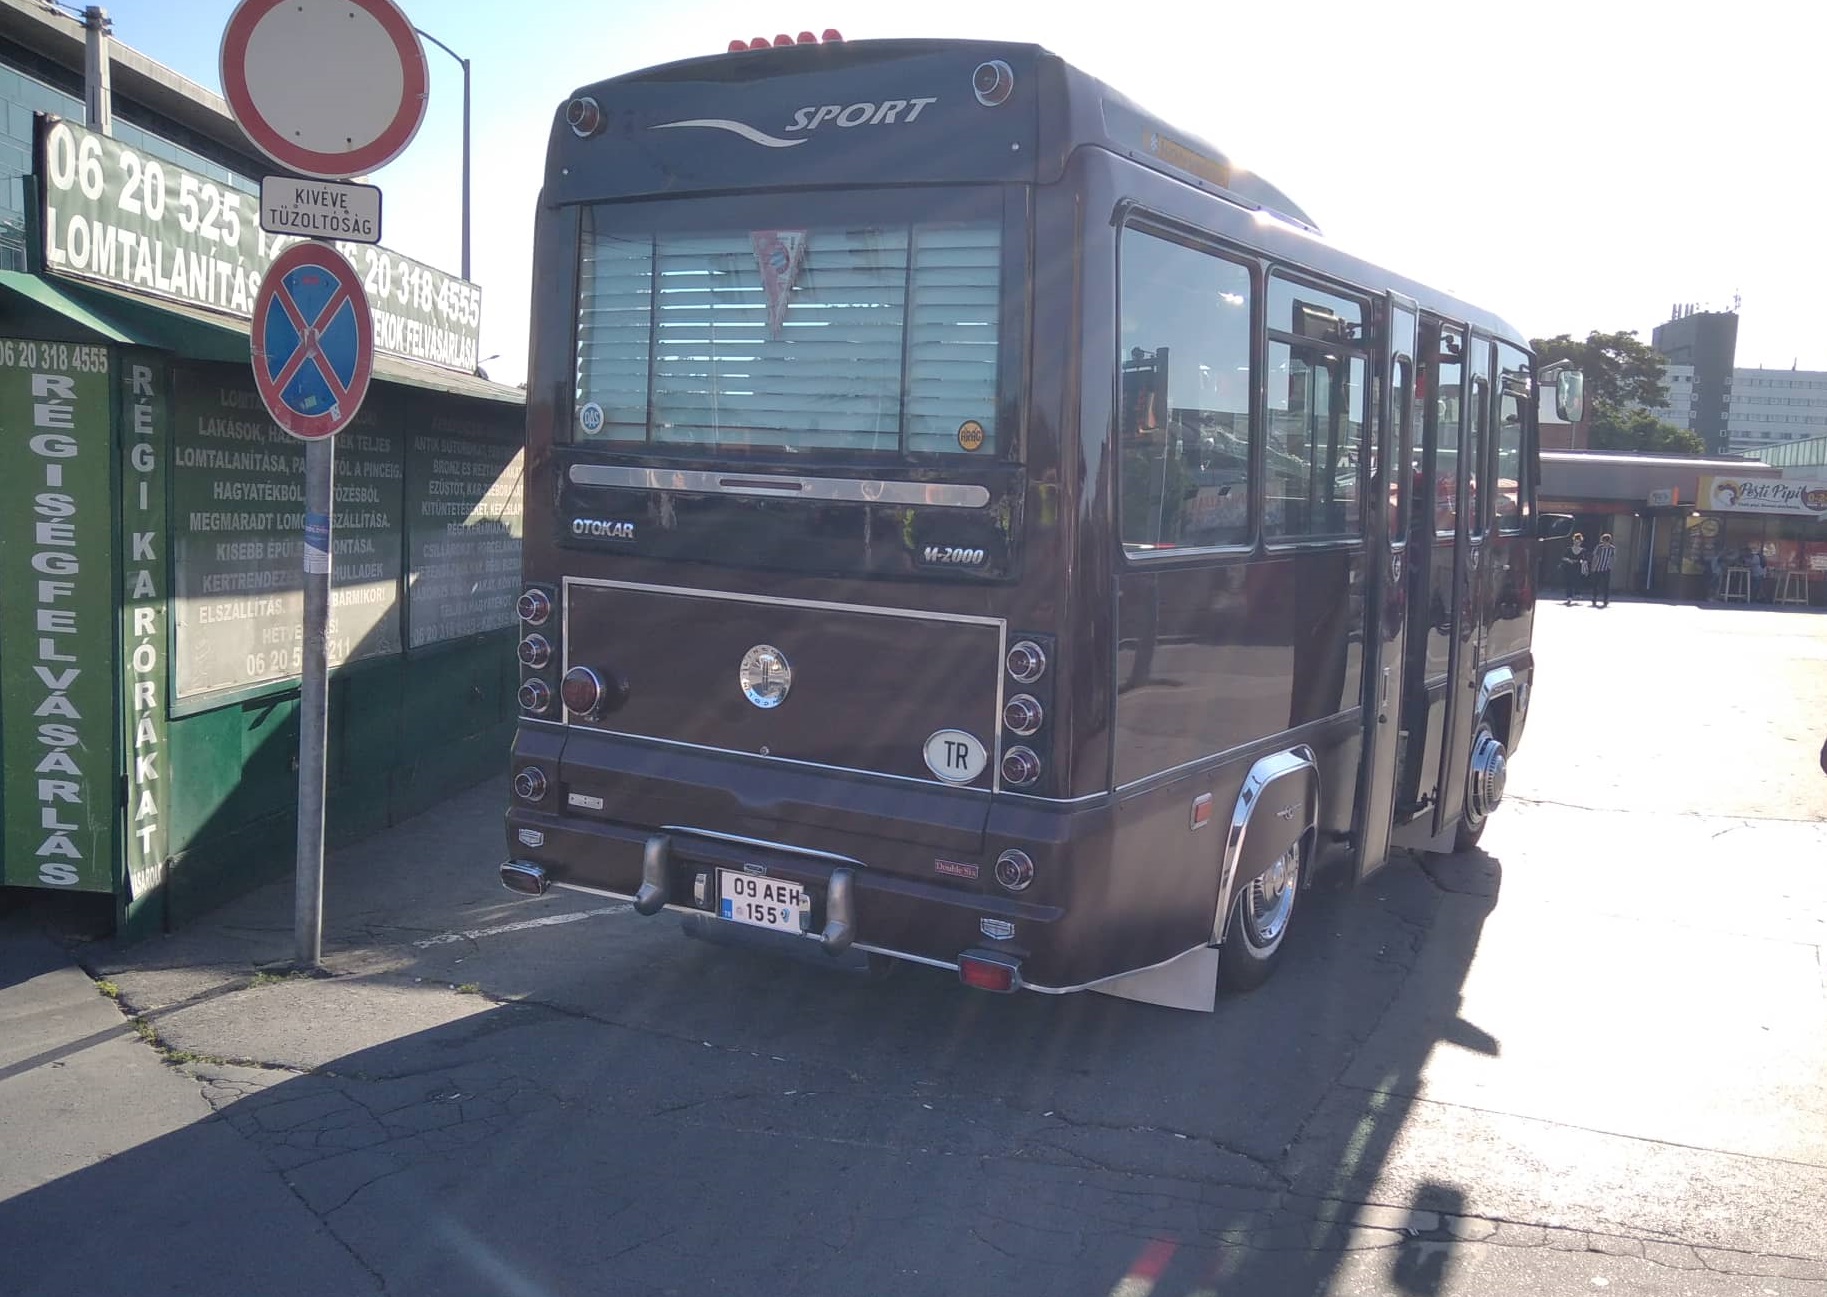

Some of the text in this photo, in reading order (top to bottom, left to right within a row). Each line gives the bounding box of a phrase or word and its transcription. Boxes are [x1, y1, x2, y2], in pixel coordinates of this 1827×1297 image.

[785, 97, 938, 132] SPORT
[48, 123, 104, 200] 06
[118, 150, 166, 221] 20
[178, 173, 241, 247] 525
[295, 186, 348, 209] KIVÉVE
[364, 248, 392, 298] 20
[397, 261, 433, 313] 318
[437, 277, 480, 328] 4555
[19, 342, 37, 369] 20
[41, 344, 68, 371] 318
[72, 346, 109, 374] 4555
[189, 511, 274, 532] MEGMARADT
[572, 518, 634, 538] OTOKAR
[216, 541, 264, 562] KISEBB
[246, 652, 265, 677] 06
[270, 650, 288, 673] 20
[944, 740, 968, 770] TR
[734, 877, 800, 907] 09 AEH
[746, 903, 777, 924] 155
